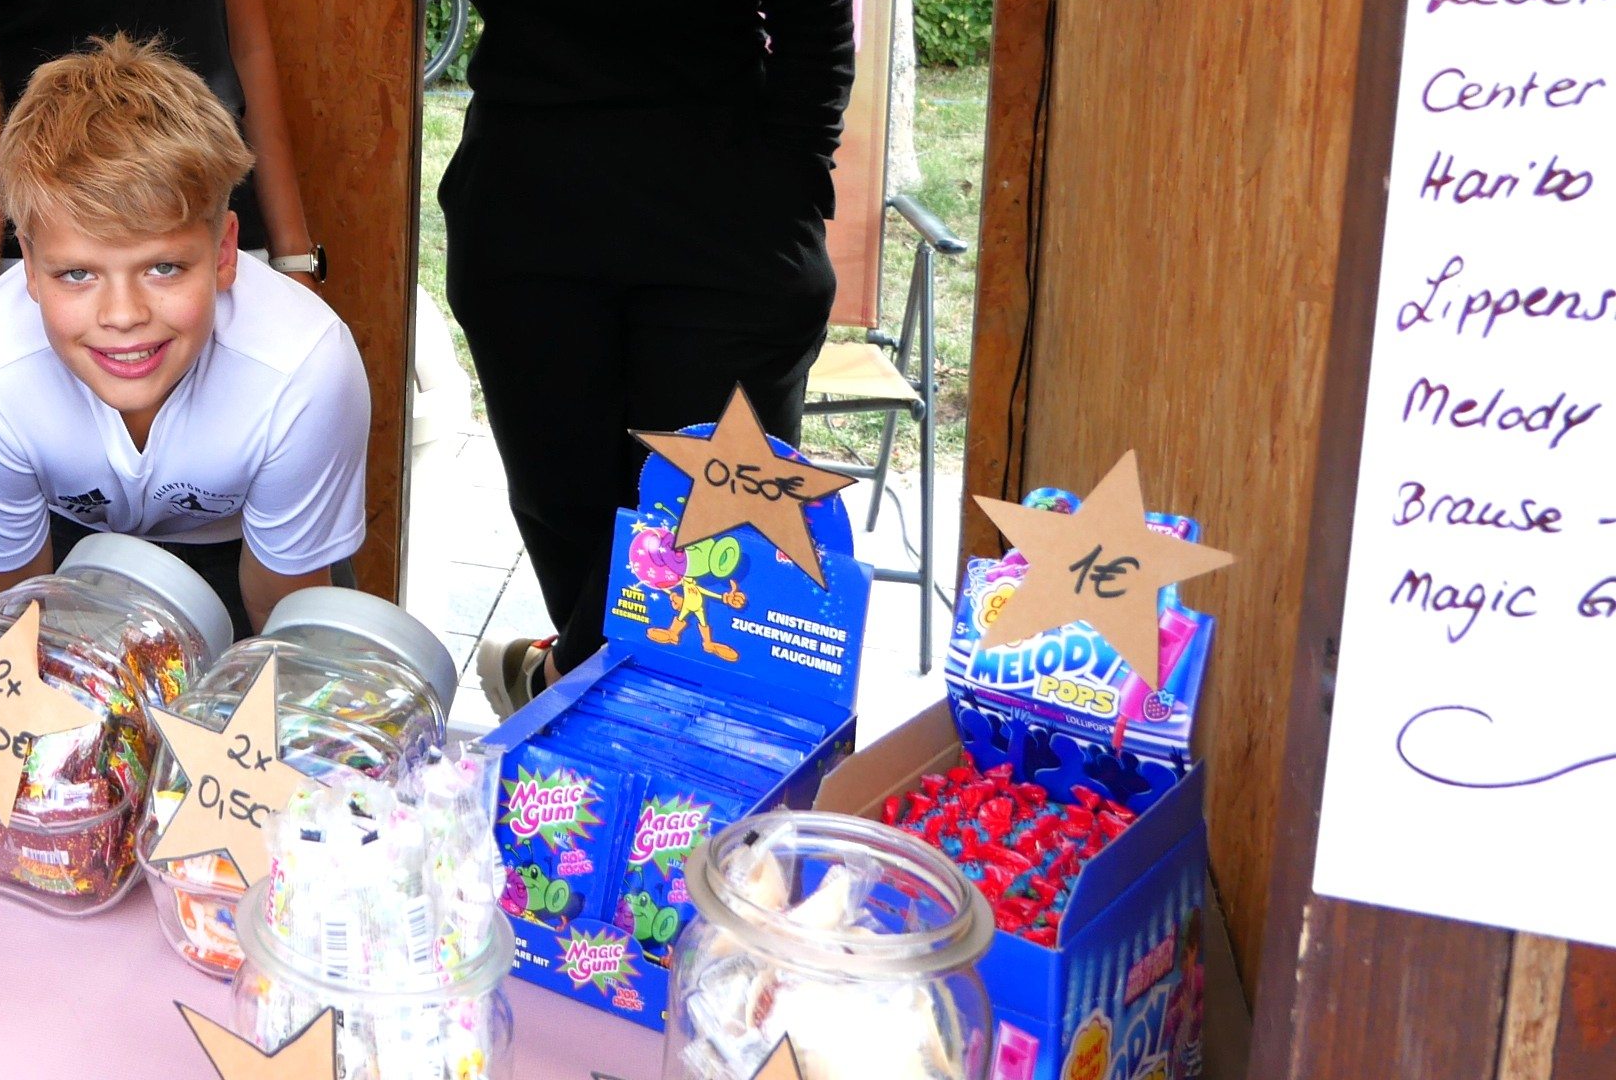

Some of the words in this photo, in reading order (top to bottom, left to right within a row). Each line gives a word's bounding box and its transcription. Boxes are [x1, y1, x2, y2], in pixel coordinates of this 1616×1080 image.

[1421, 67, 1607, 113] Center
[1419, 150, 1594, 204] Haribo
[1402, 377, 1603, 450] Melody
[1392, 480, 1563, 534] Brause
[1068, 544, 1141, 600] 1€
[617, 599, 647, 614] FRUTTI
[621, 587, 646, 601] TUTTI
[1390, 568, 1537, 644] Magic
[731, 617, 817, 652] ZUCKERWARE
[819, 644, 845, 659] MIT
[767, 610, 847, 642] KNISTERNDE
[770, 645, 842, 676] KAUGUMMI
[970, 634, 1119, 685] MELODY
[1037, 676, 1116, 715] POPS
[228, 733, 274, 772] 2x
[532, 955, 551, 968] MIT
